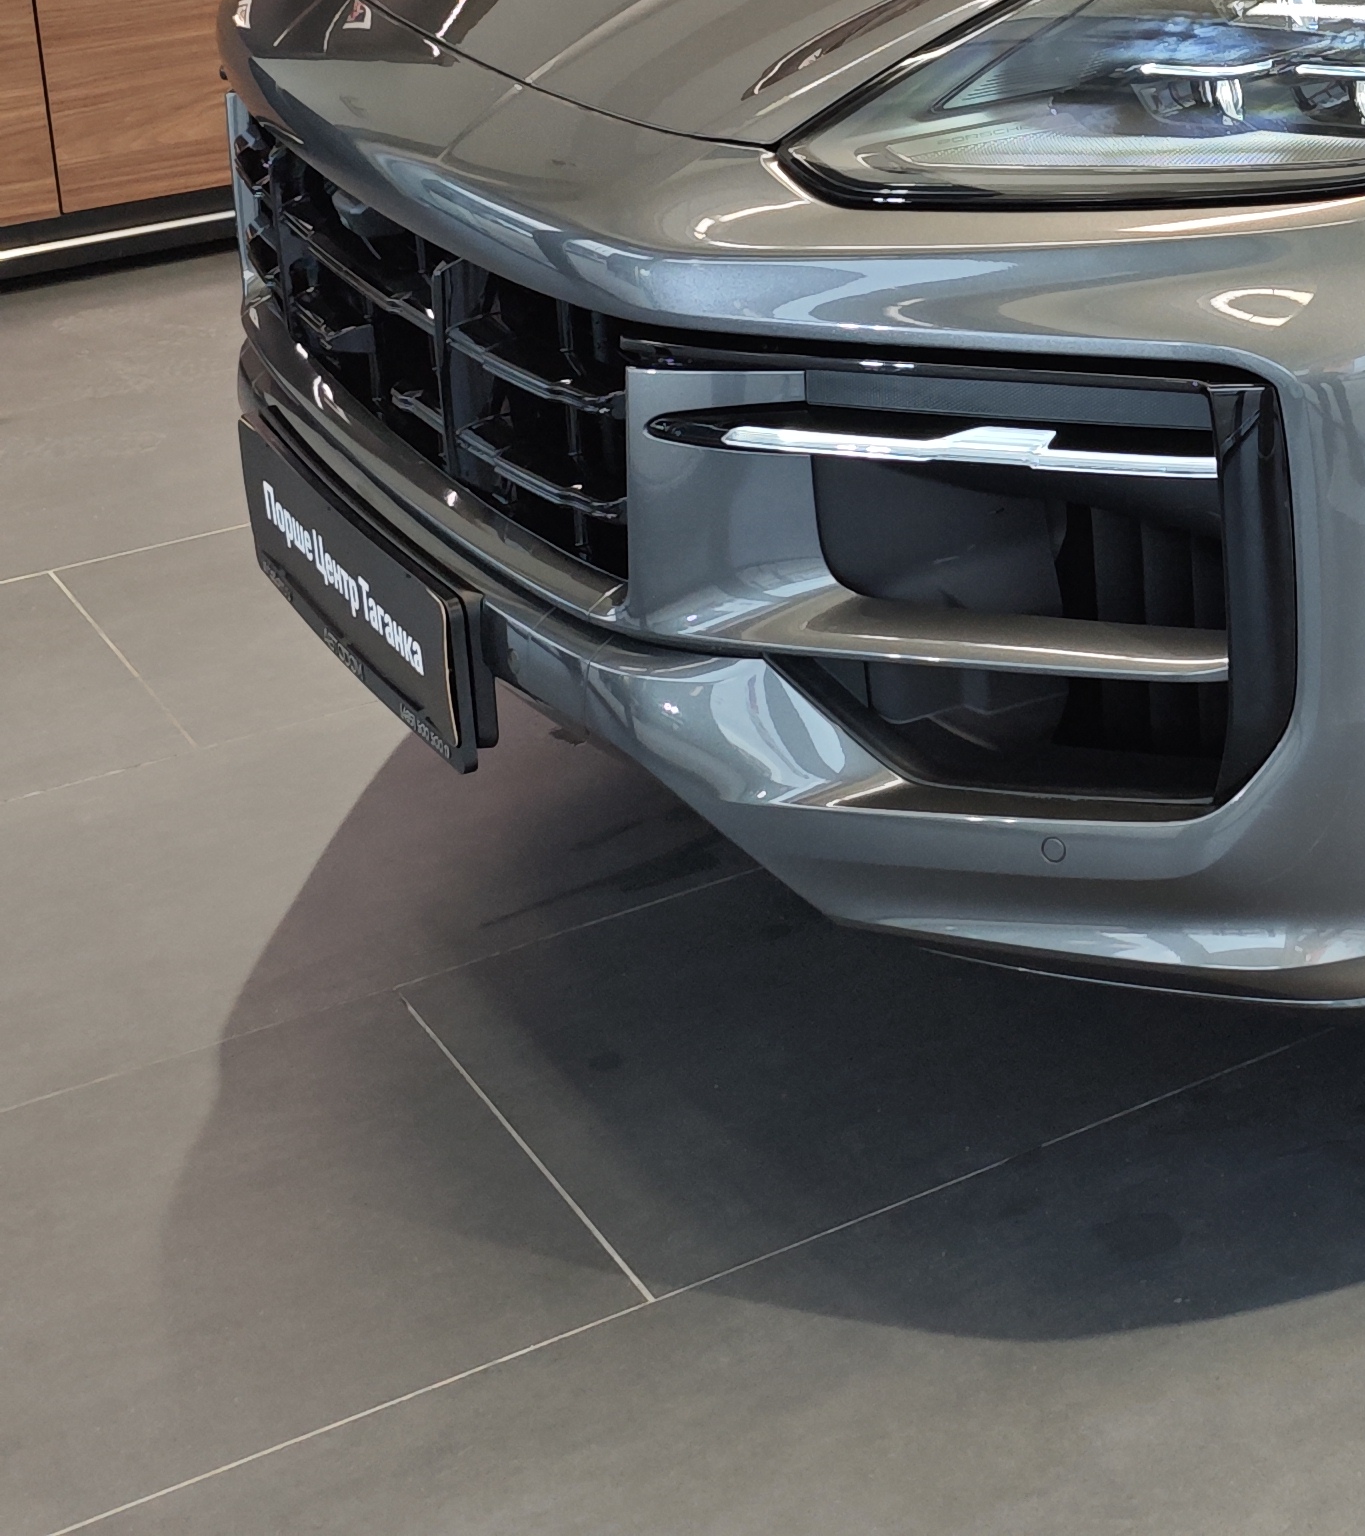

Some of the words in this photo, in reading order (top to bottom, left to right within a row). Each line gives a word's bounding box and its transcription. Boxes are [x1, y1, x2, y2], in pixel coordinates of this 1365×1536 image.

[262, 480, 313, 563] Порше
[312, 529, 360, 617] Центр
[357, 576, 424, 676] Таганка
